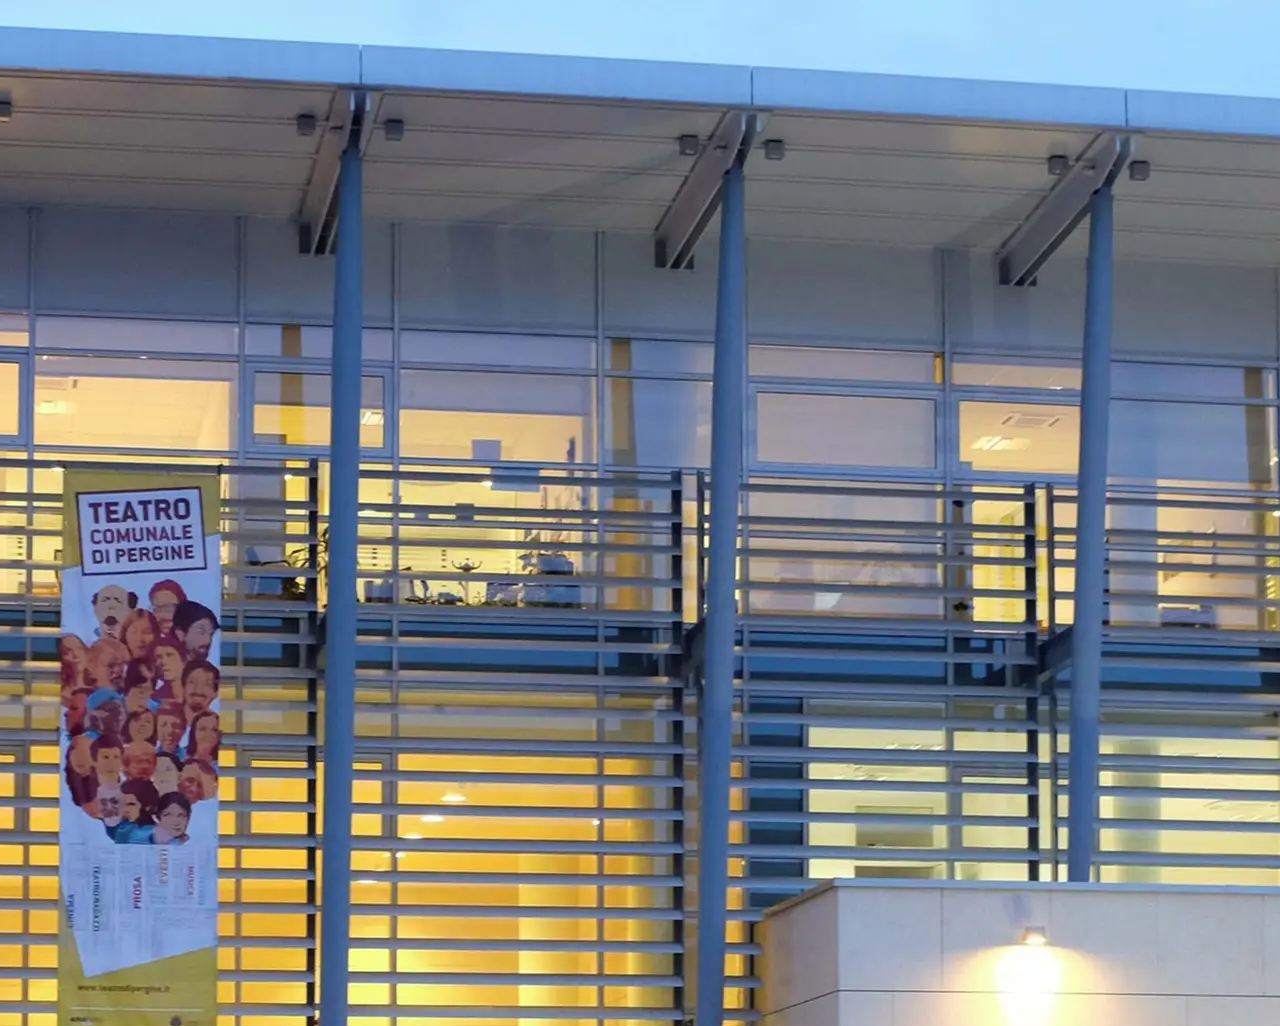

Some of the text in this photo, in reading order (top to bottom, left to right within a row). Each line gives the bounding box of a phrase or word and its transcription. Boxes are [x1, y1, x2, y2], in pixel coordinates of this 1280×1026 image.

[88, 497, 191, 524] TEATRO
[90, 524, 193, 545] COMUNALE
[91, 545, 195, 564] DI PERGINE
[133, 876, 143, 910] PROSA
